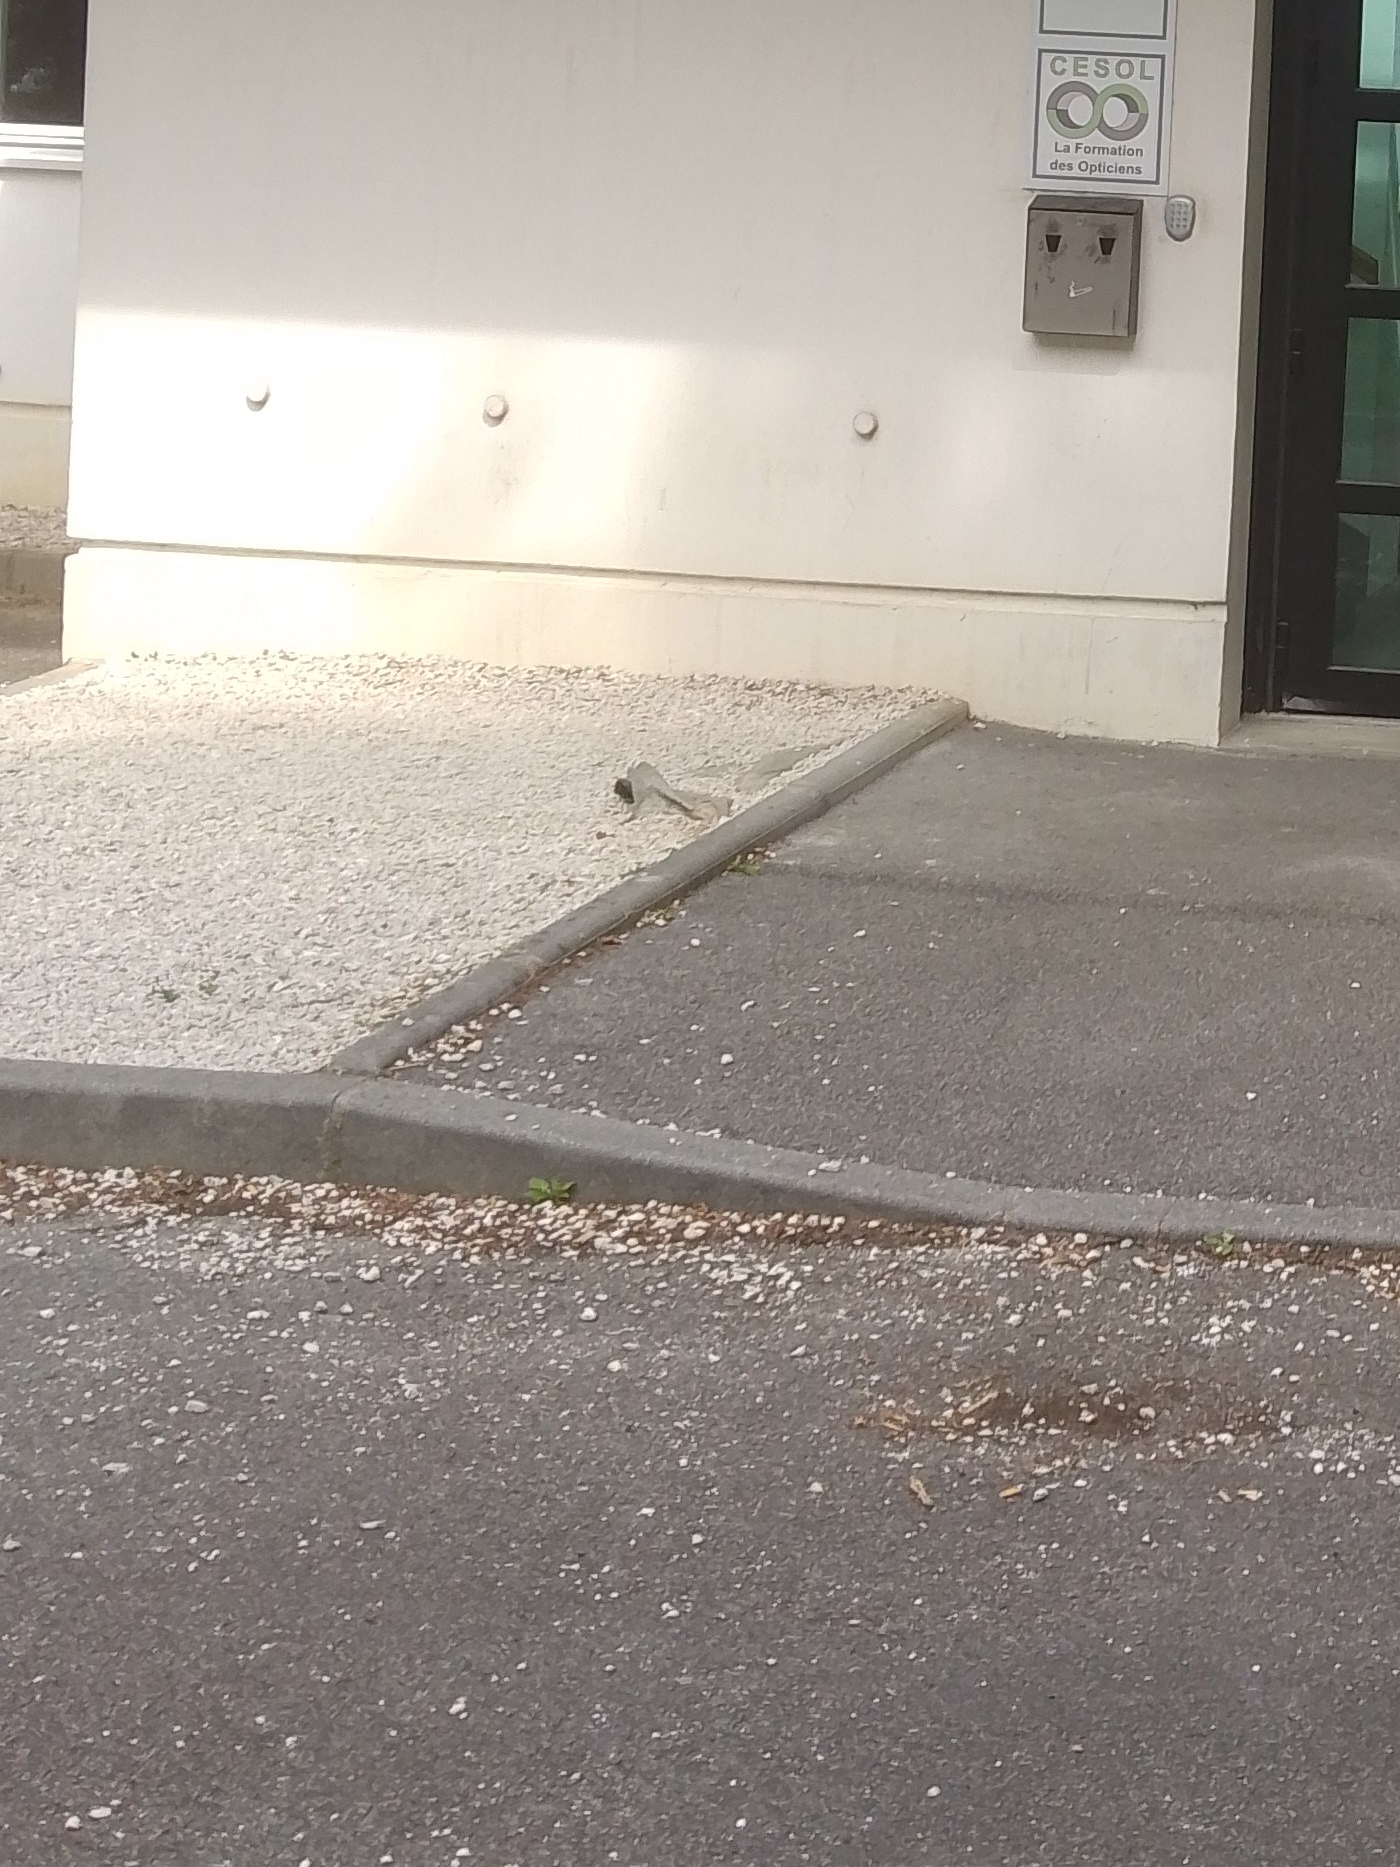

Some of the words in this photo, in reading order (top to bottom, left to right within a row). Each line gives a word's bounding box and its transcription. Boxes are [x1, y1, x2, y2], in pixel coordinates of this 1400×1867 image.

[1050, 55, 1155, 81] CESOL
[1054, 141, 1071, 154] La
[1074, 142, 1144, 158] Formation
[1049, 159, 1074, 172] des
[1078, 160, 1143, 176] Opticiens
